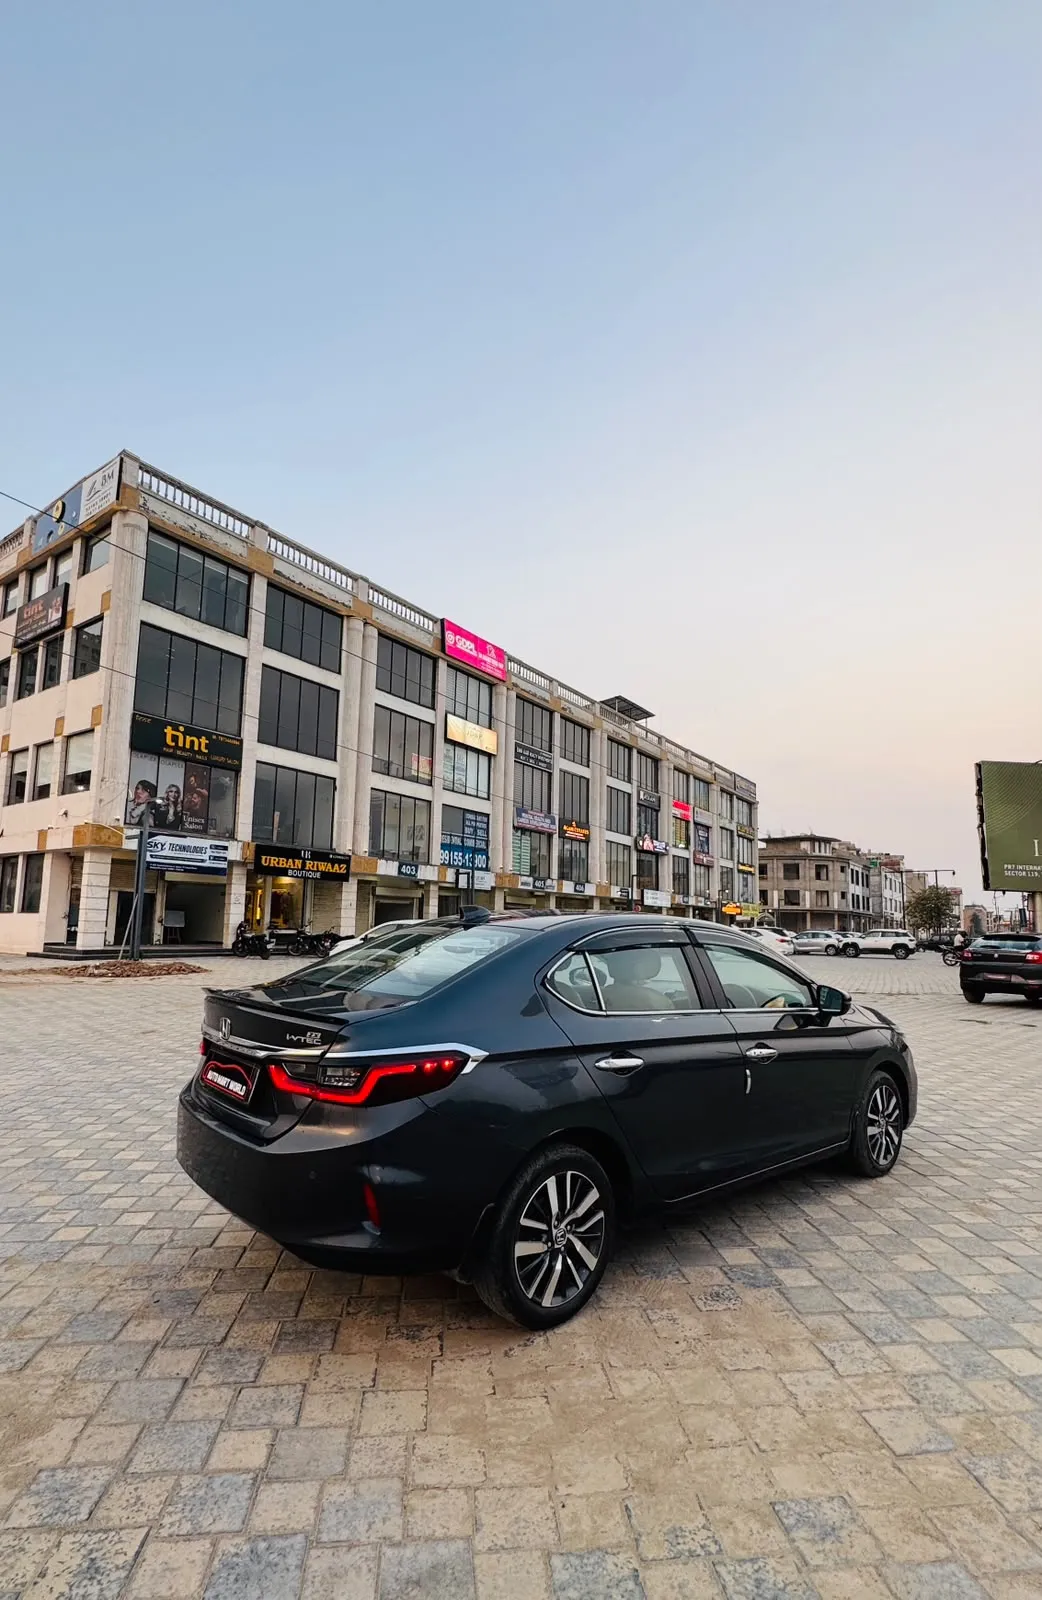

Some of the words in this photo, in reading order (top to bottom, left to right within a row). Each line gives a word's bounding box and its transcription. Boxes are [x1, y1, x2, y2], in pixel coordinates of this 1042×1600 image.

[164, 725, 209, 753] tint
[183, 815, 205, 824] Unisex
[184, 822, 204, 830] Salon
[147, 841, 166, 851] SKY
[168, 843, 208, 855] TECHNOLOGIES
[261, 855, 302, 869] URBAN
[305, 860, 347, 874] RIWAAZ
[400, 864, 416, 875] 403
[287, 869, 321, 879] BOUTIQUE
